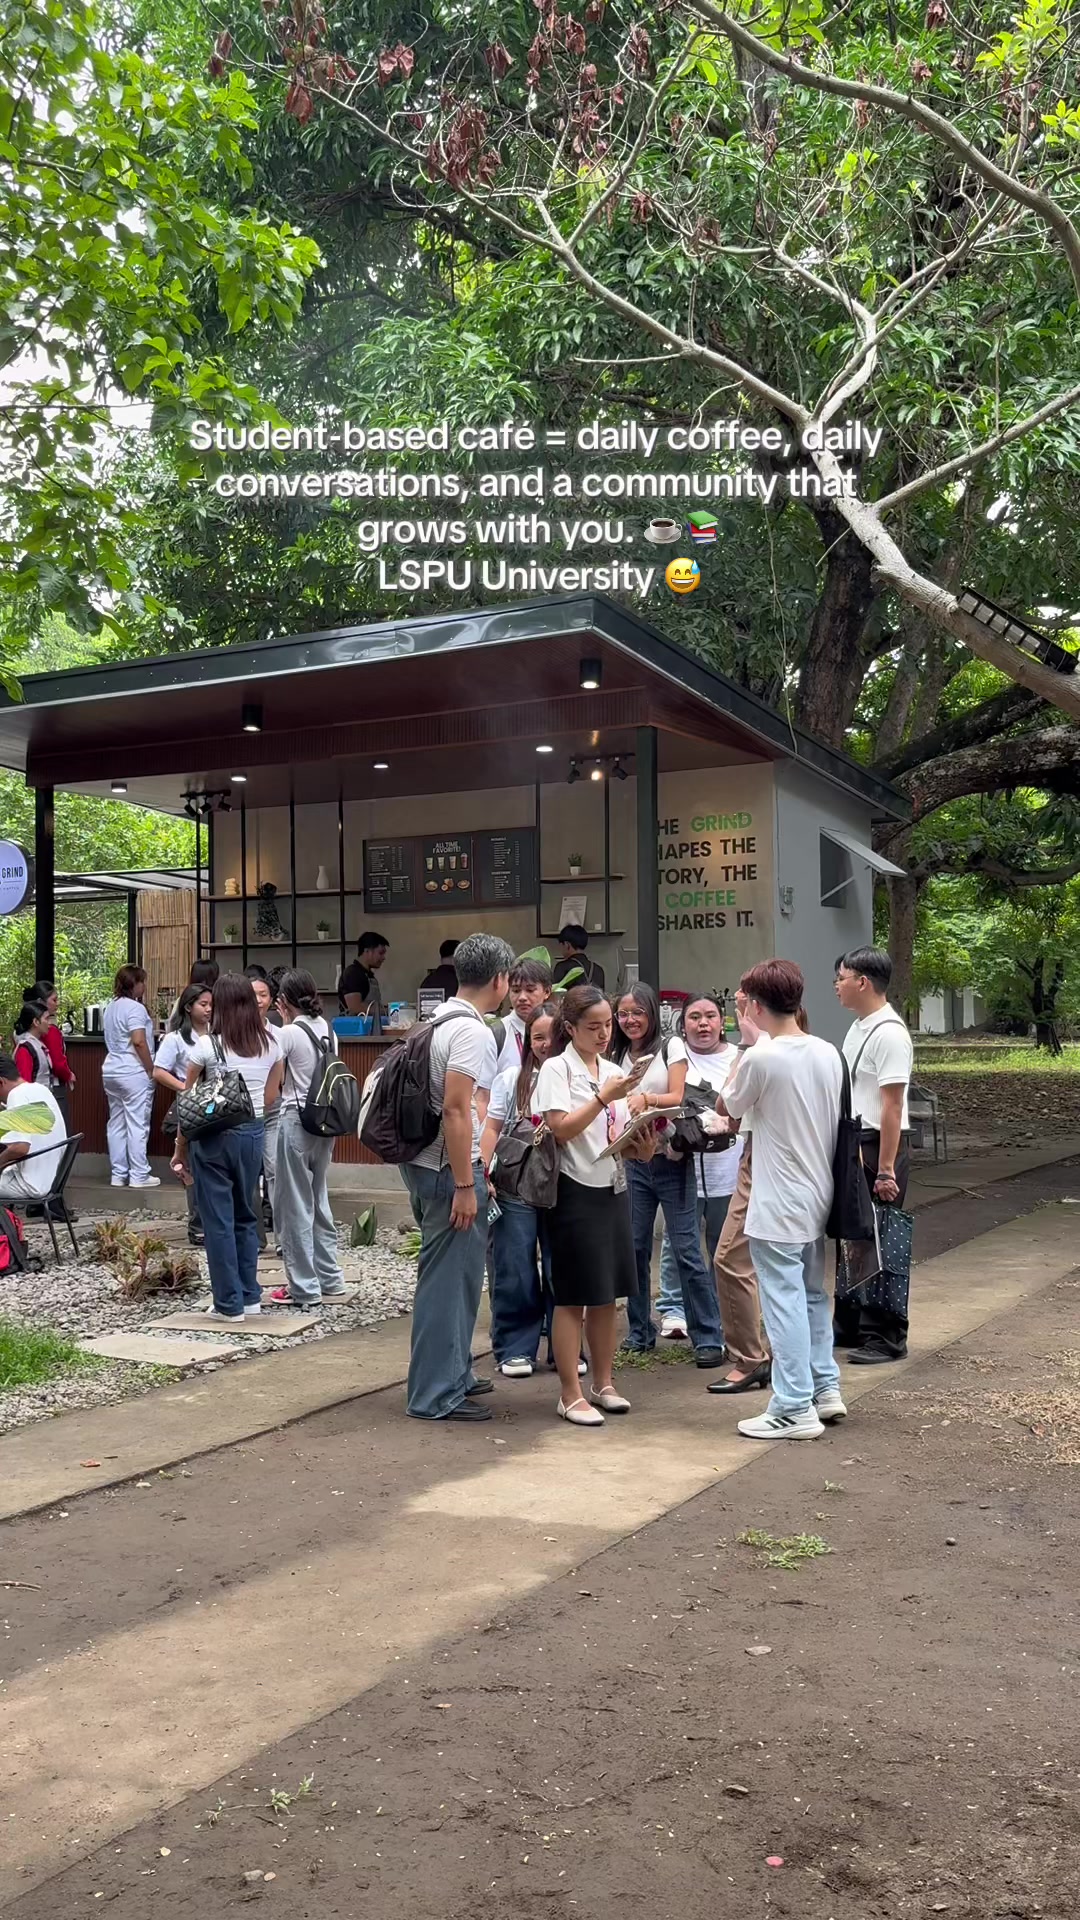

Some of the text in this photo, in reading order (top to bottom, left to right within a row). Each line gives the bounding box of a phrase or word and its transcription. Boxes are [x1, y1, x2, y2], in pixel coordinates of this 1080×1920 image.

[657, 811, 752, 836] HE GRIND
[720, 837, 756, 855] THE
[2, 866, 24, 878] GRIND
[657, 864, 757, 887] TORY, THE
[665, 890, 737, 908] COFFEE
[736, 910, 754, 927] IT.
